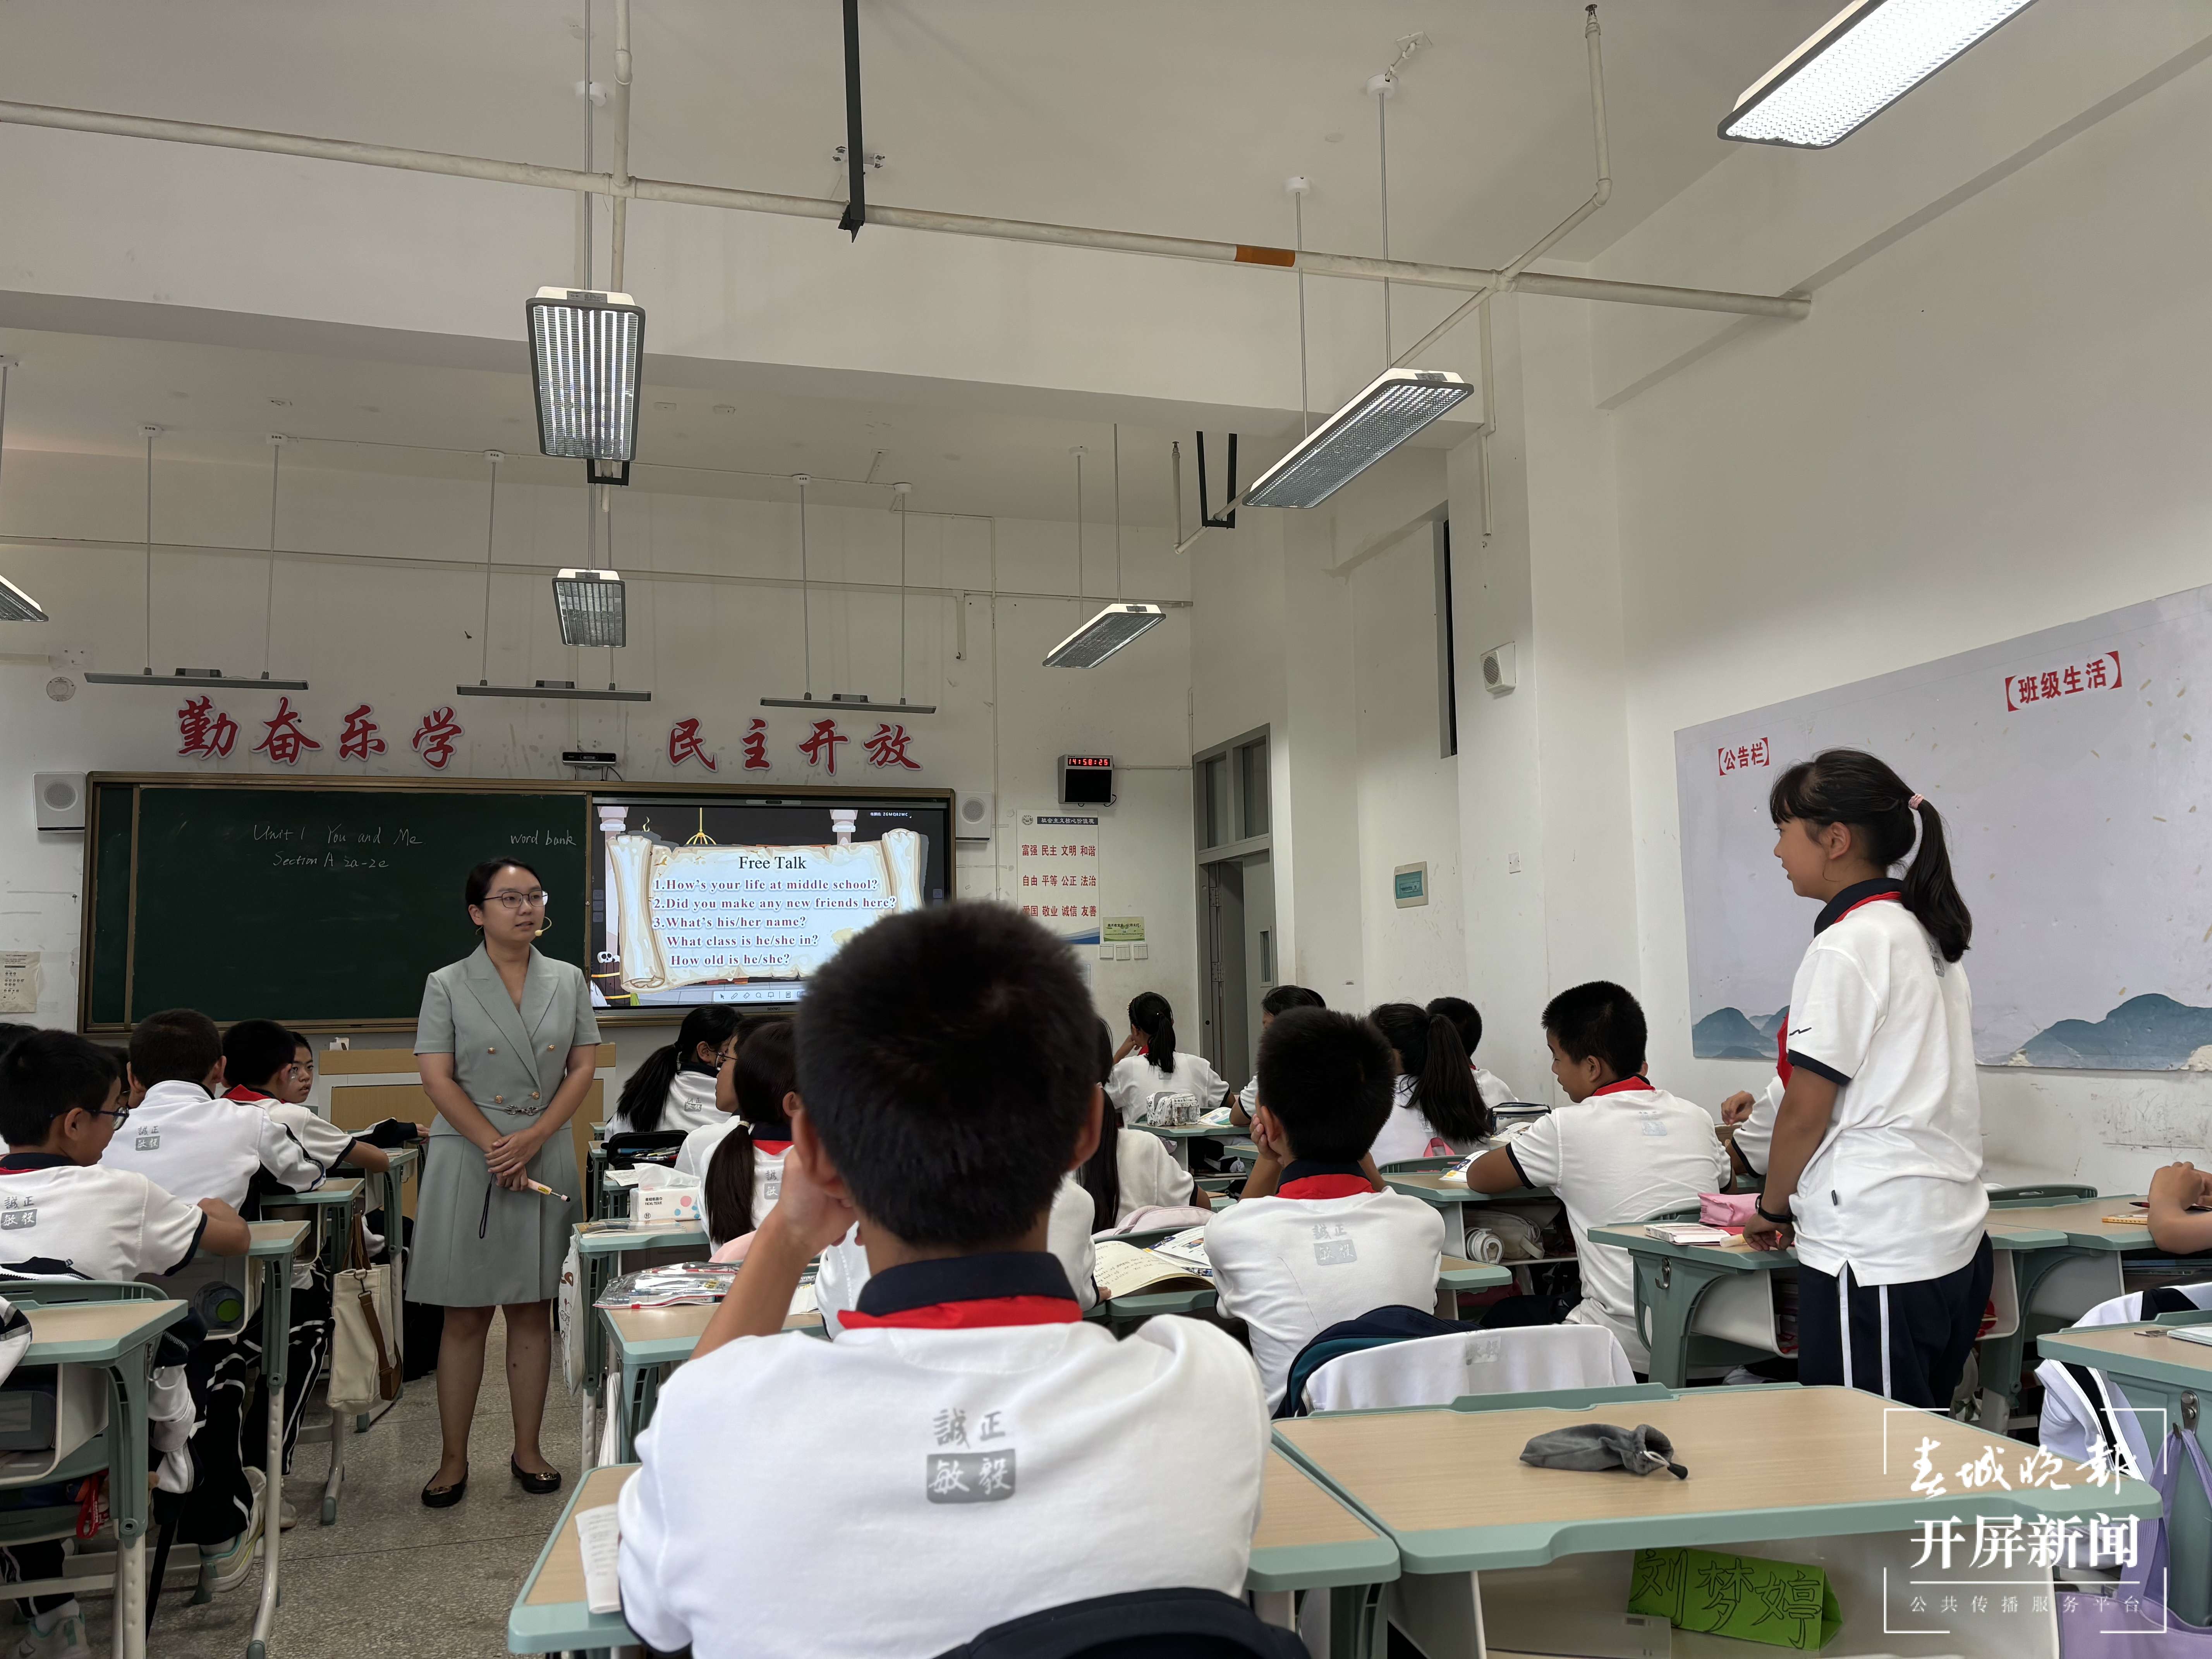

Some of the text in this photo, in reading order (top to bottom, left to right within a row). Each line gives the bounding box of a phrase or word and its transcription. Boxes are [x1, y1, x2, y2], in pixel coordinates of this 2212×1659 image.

[177, 696, 462, 768] 勤奋乐学
[669, 718, 921, 774] 民主开放
[254, 824, 294, 840] Unit
[328, 824, 347, 843] You
[358, 827, 381, 844] and
[393, 828, 423, 846] Me
[510, 830, 577, 845] word bank
[1022, 845, 1096, 856] 富强 民主 文明 和谐
[273, 851, 317, 866] Section
[324, 852, 333, 867] A
[738, 856, 807, 869] Free Talk
[711, 882, 740, 891] your
[745, 879, 765, 889] life
[770, 881, 781, 889] at
[787, 879, 828, 889] middle
[833, 879, 878, 889] school?
[1023, 875, 1096, 886] 自由 平等 公正 法治
[694, 901, 716, 910] you
[722, 898, 755, 908] make
[760, 901, 781, 910] any
[816, 898, 858, 908] friends
[863, 897, 895, 907] here?
[1042, 905, 1058, 917] 敬业
[1062, 905, 1077, 917] 诚信
[1081, 905, 1097, 917] 友善
[718, 917, 761, 927] his/her
[766, 916, 806, 926] name?
[667, 934, 818, 946] What class is he/she in?
[671, 953, 790, 965] How old is he/she?
[1629, 1549, 1822, 1650] 刘梦婷
